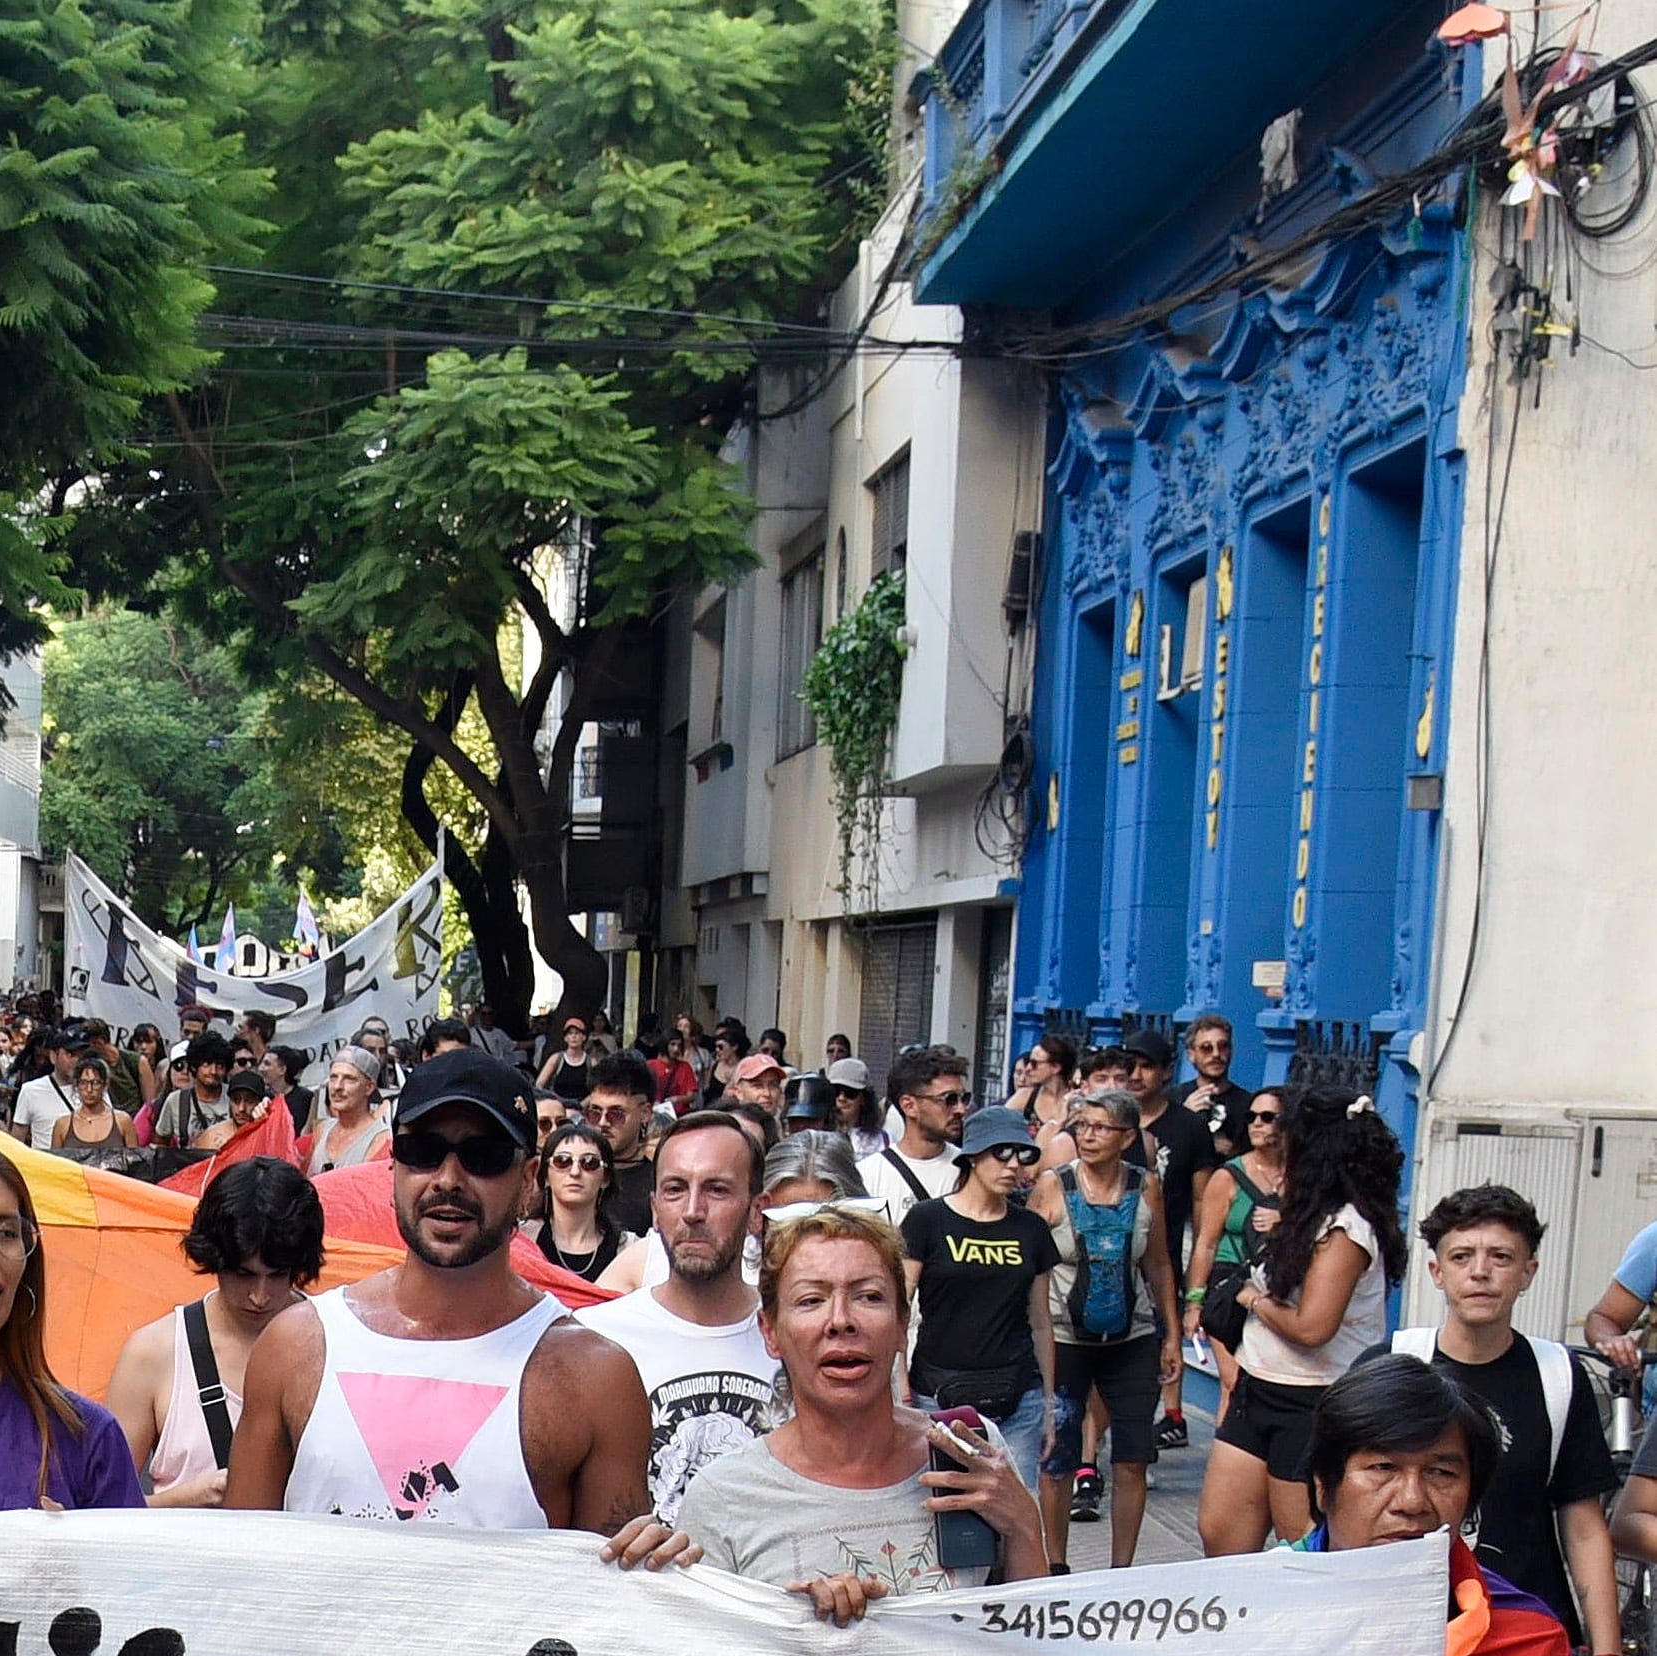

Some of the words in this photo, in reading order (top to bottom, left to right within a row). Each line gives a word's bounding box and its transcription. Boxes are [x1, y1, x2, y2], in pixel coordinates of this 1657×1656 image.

[945, 1234, 1023, 1265] VANS
[658, 1375, 720, 1404] MARIHUANA
[721, 1375, 773, 1403] SOBERANA
[978, 1595, 1228, 1642] 3415699966
